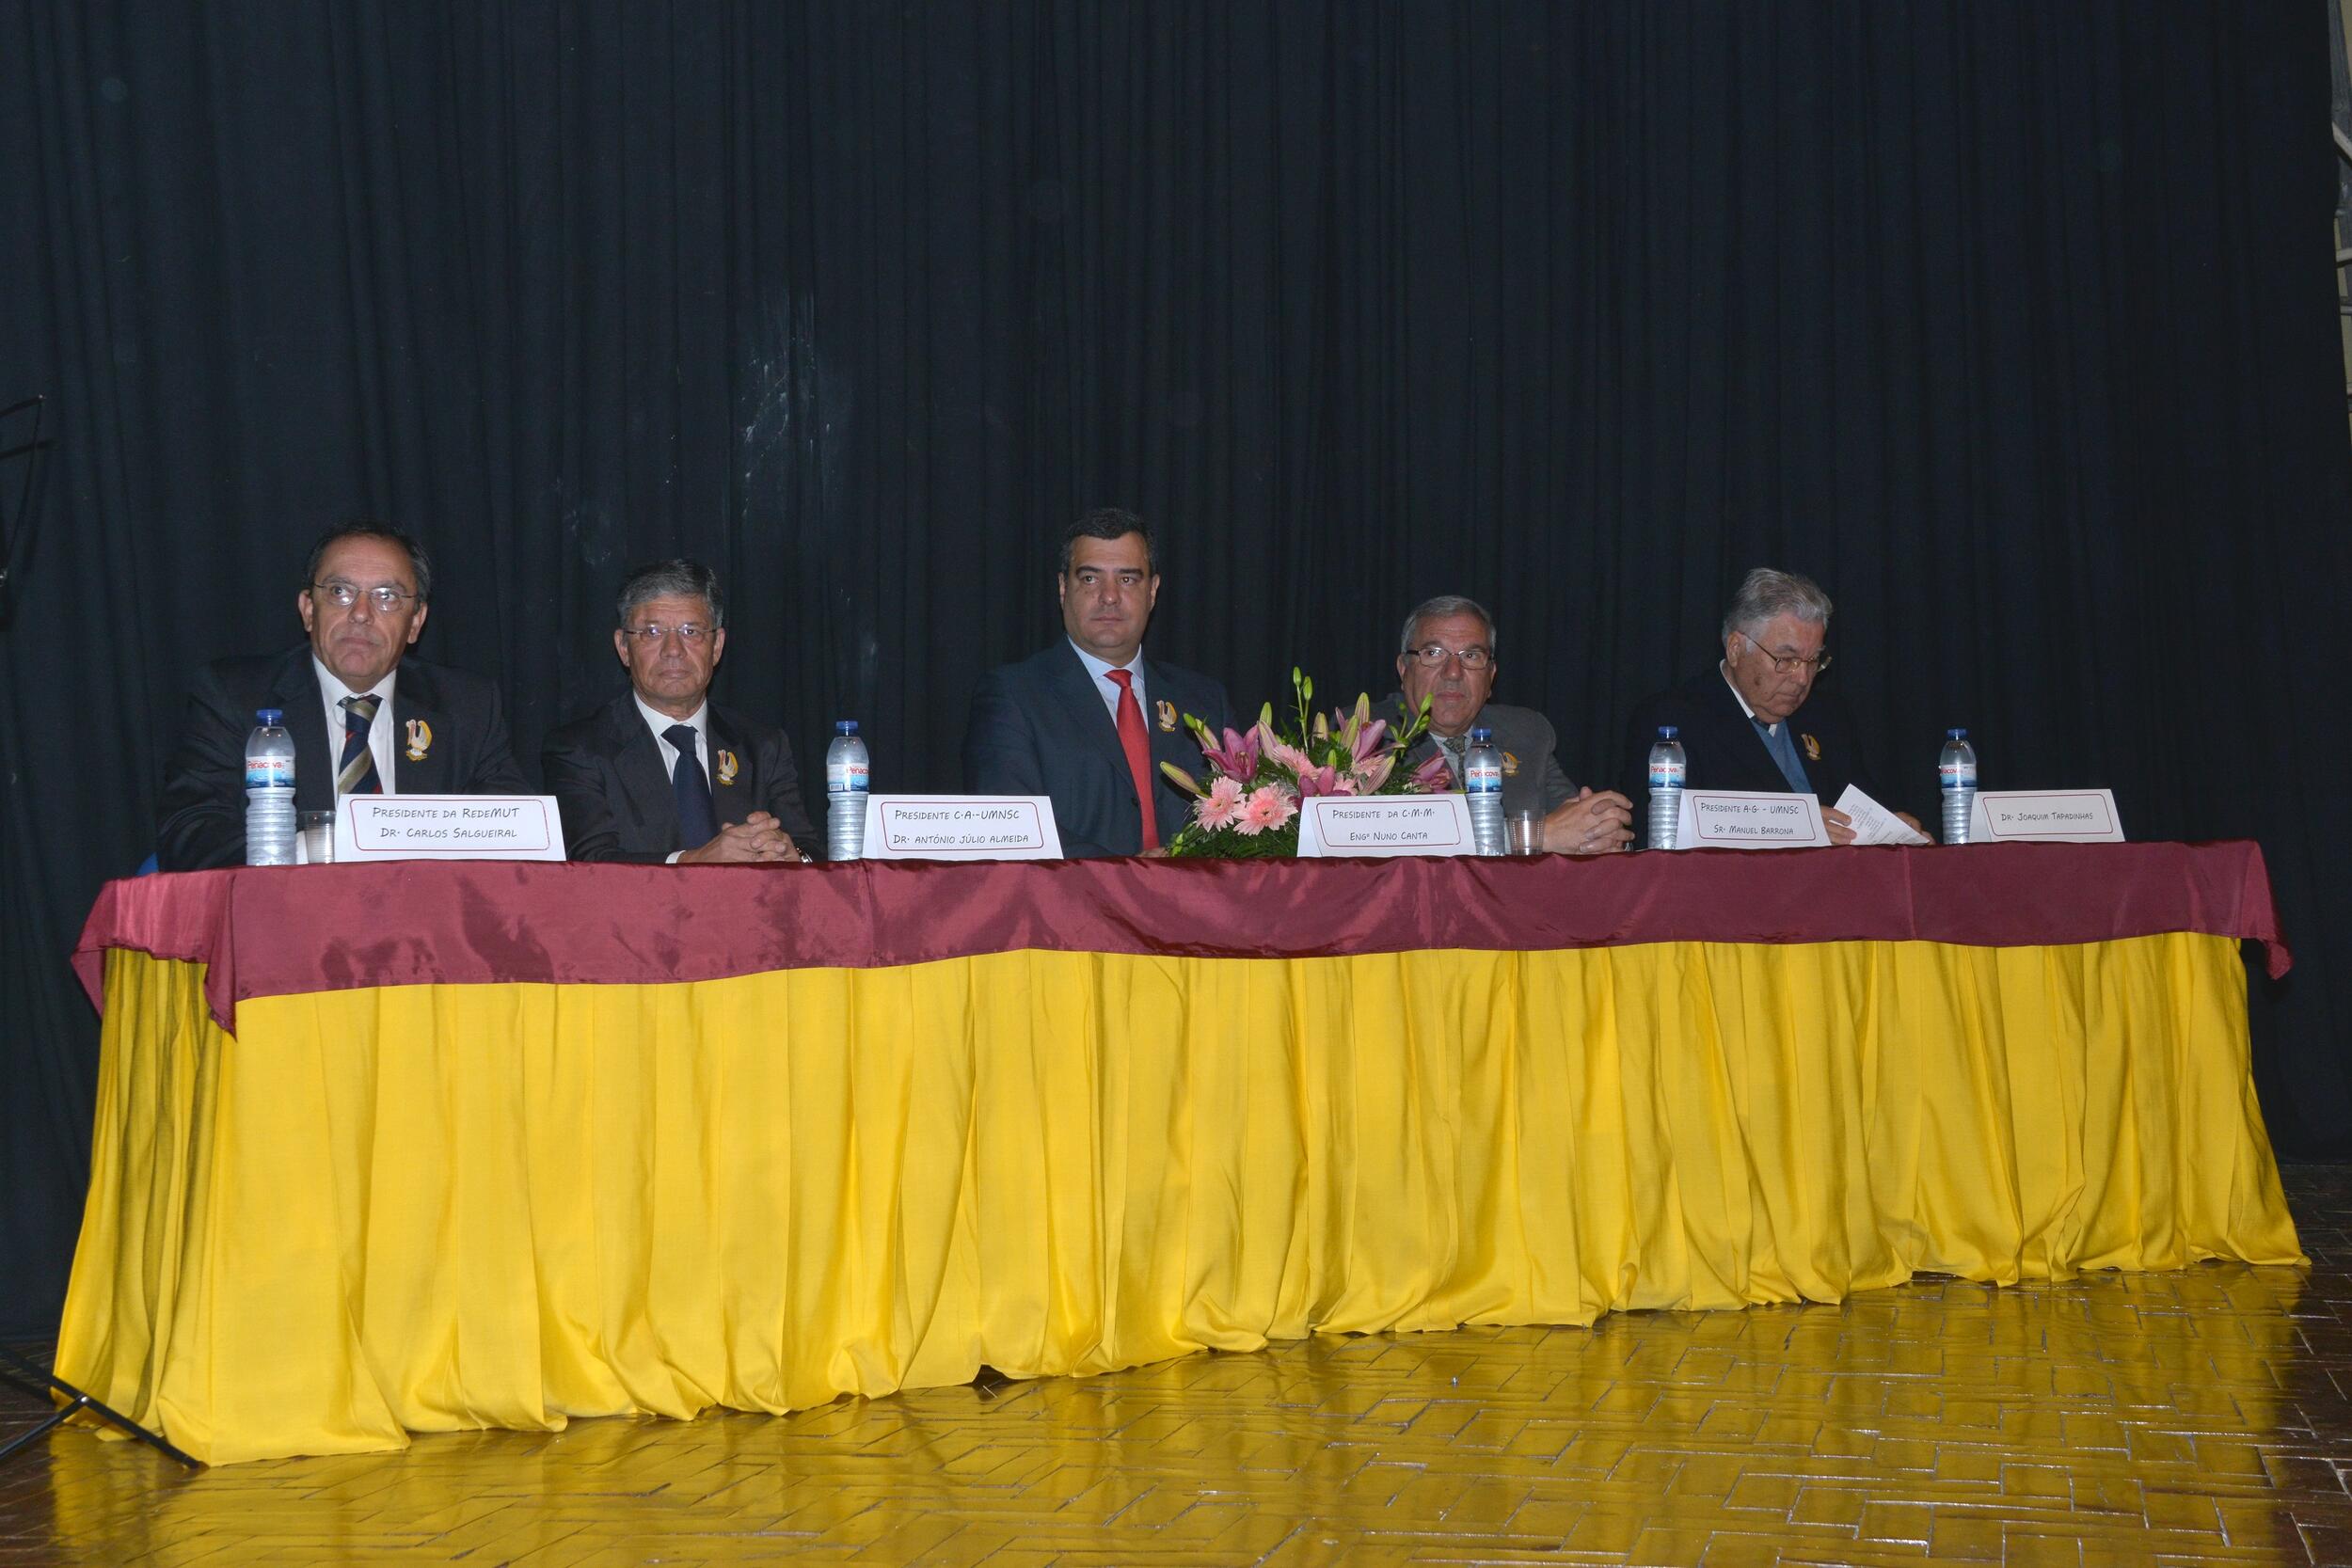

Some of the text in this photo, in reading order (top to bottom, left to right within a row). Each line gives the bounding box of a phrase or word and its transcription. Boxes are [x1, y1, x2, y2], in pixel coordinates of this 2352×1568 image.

[373, 807, 437, 818] PRESIDENTE
[443, 810, 457, 818] DA
[1701, 802, 1740, 814] PRESIDENTE
[1770, 806, 1799, 815] UMNSC
[895, 810, 949, 820] PRESIDENTE
[1332, 810, 1381, 819] PRESIDENTE
[2018, 813, 2049, 821] JOAQUIM
[406, 828, 448, 838] CARLOS
[453, 828, 517, 838] SALGUEIRAL
[1729, 825, 1758, 834] MANUEL
[914, 834, 956, 844] ANTÓNIO
[959, 833, 986, 844] JÚLIO
[990, 834, 1029, 843] ALMEIDA
[1374, 832, 1397, 841] NUNO
[1401, 832, 1428, 840] CANTA
